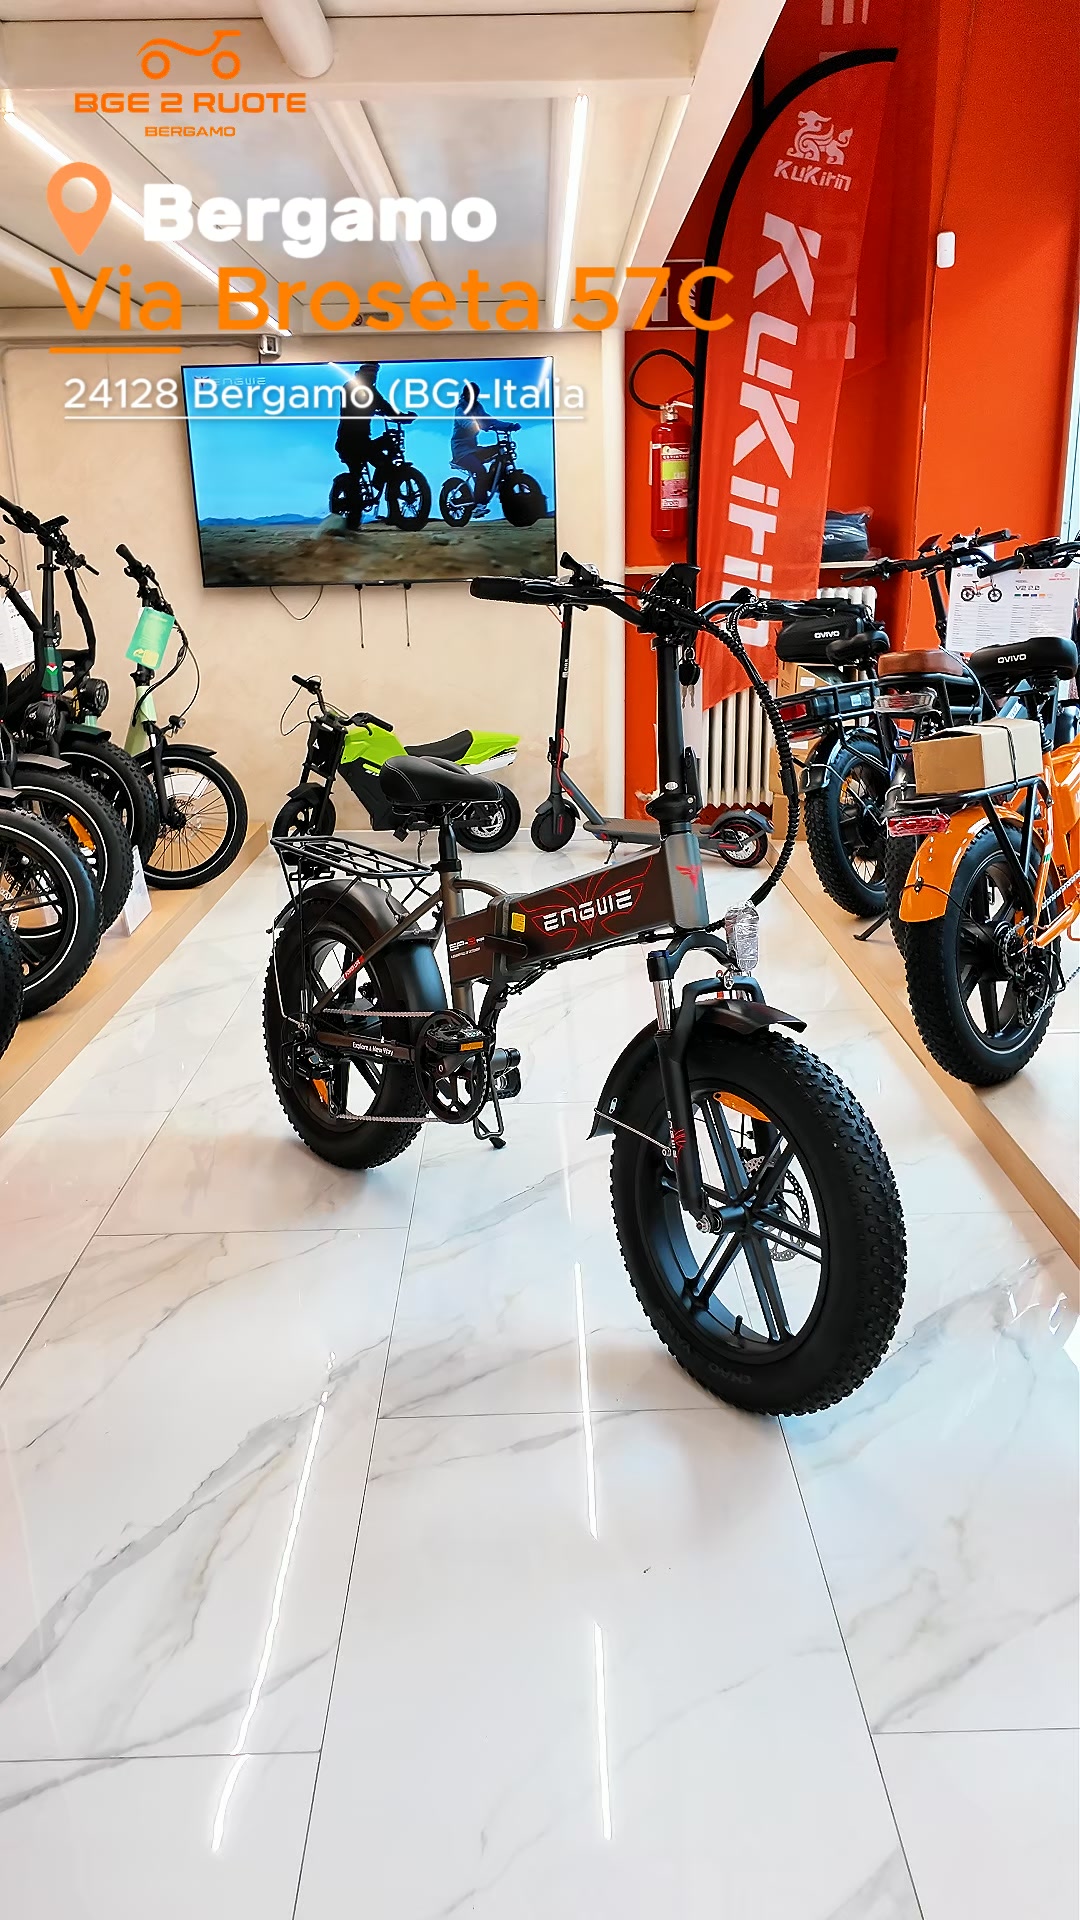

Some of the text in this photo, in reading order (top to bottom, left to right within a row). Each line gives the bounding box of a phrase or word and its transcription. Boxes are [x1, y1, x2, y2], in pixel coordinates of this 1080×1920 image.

[814, 630, 840, 639] OVIVO
[997, 653, 1027, 664] OVIVO
[543, 888, 633, 932] ENGWE
